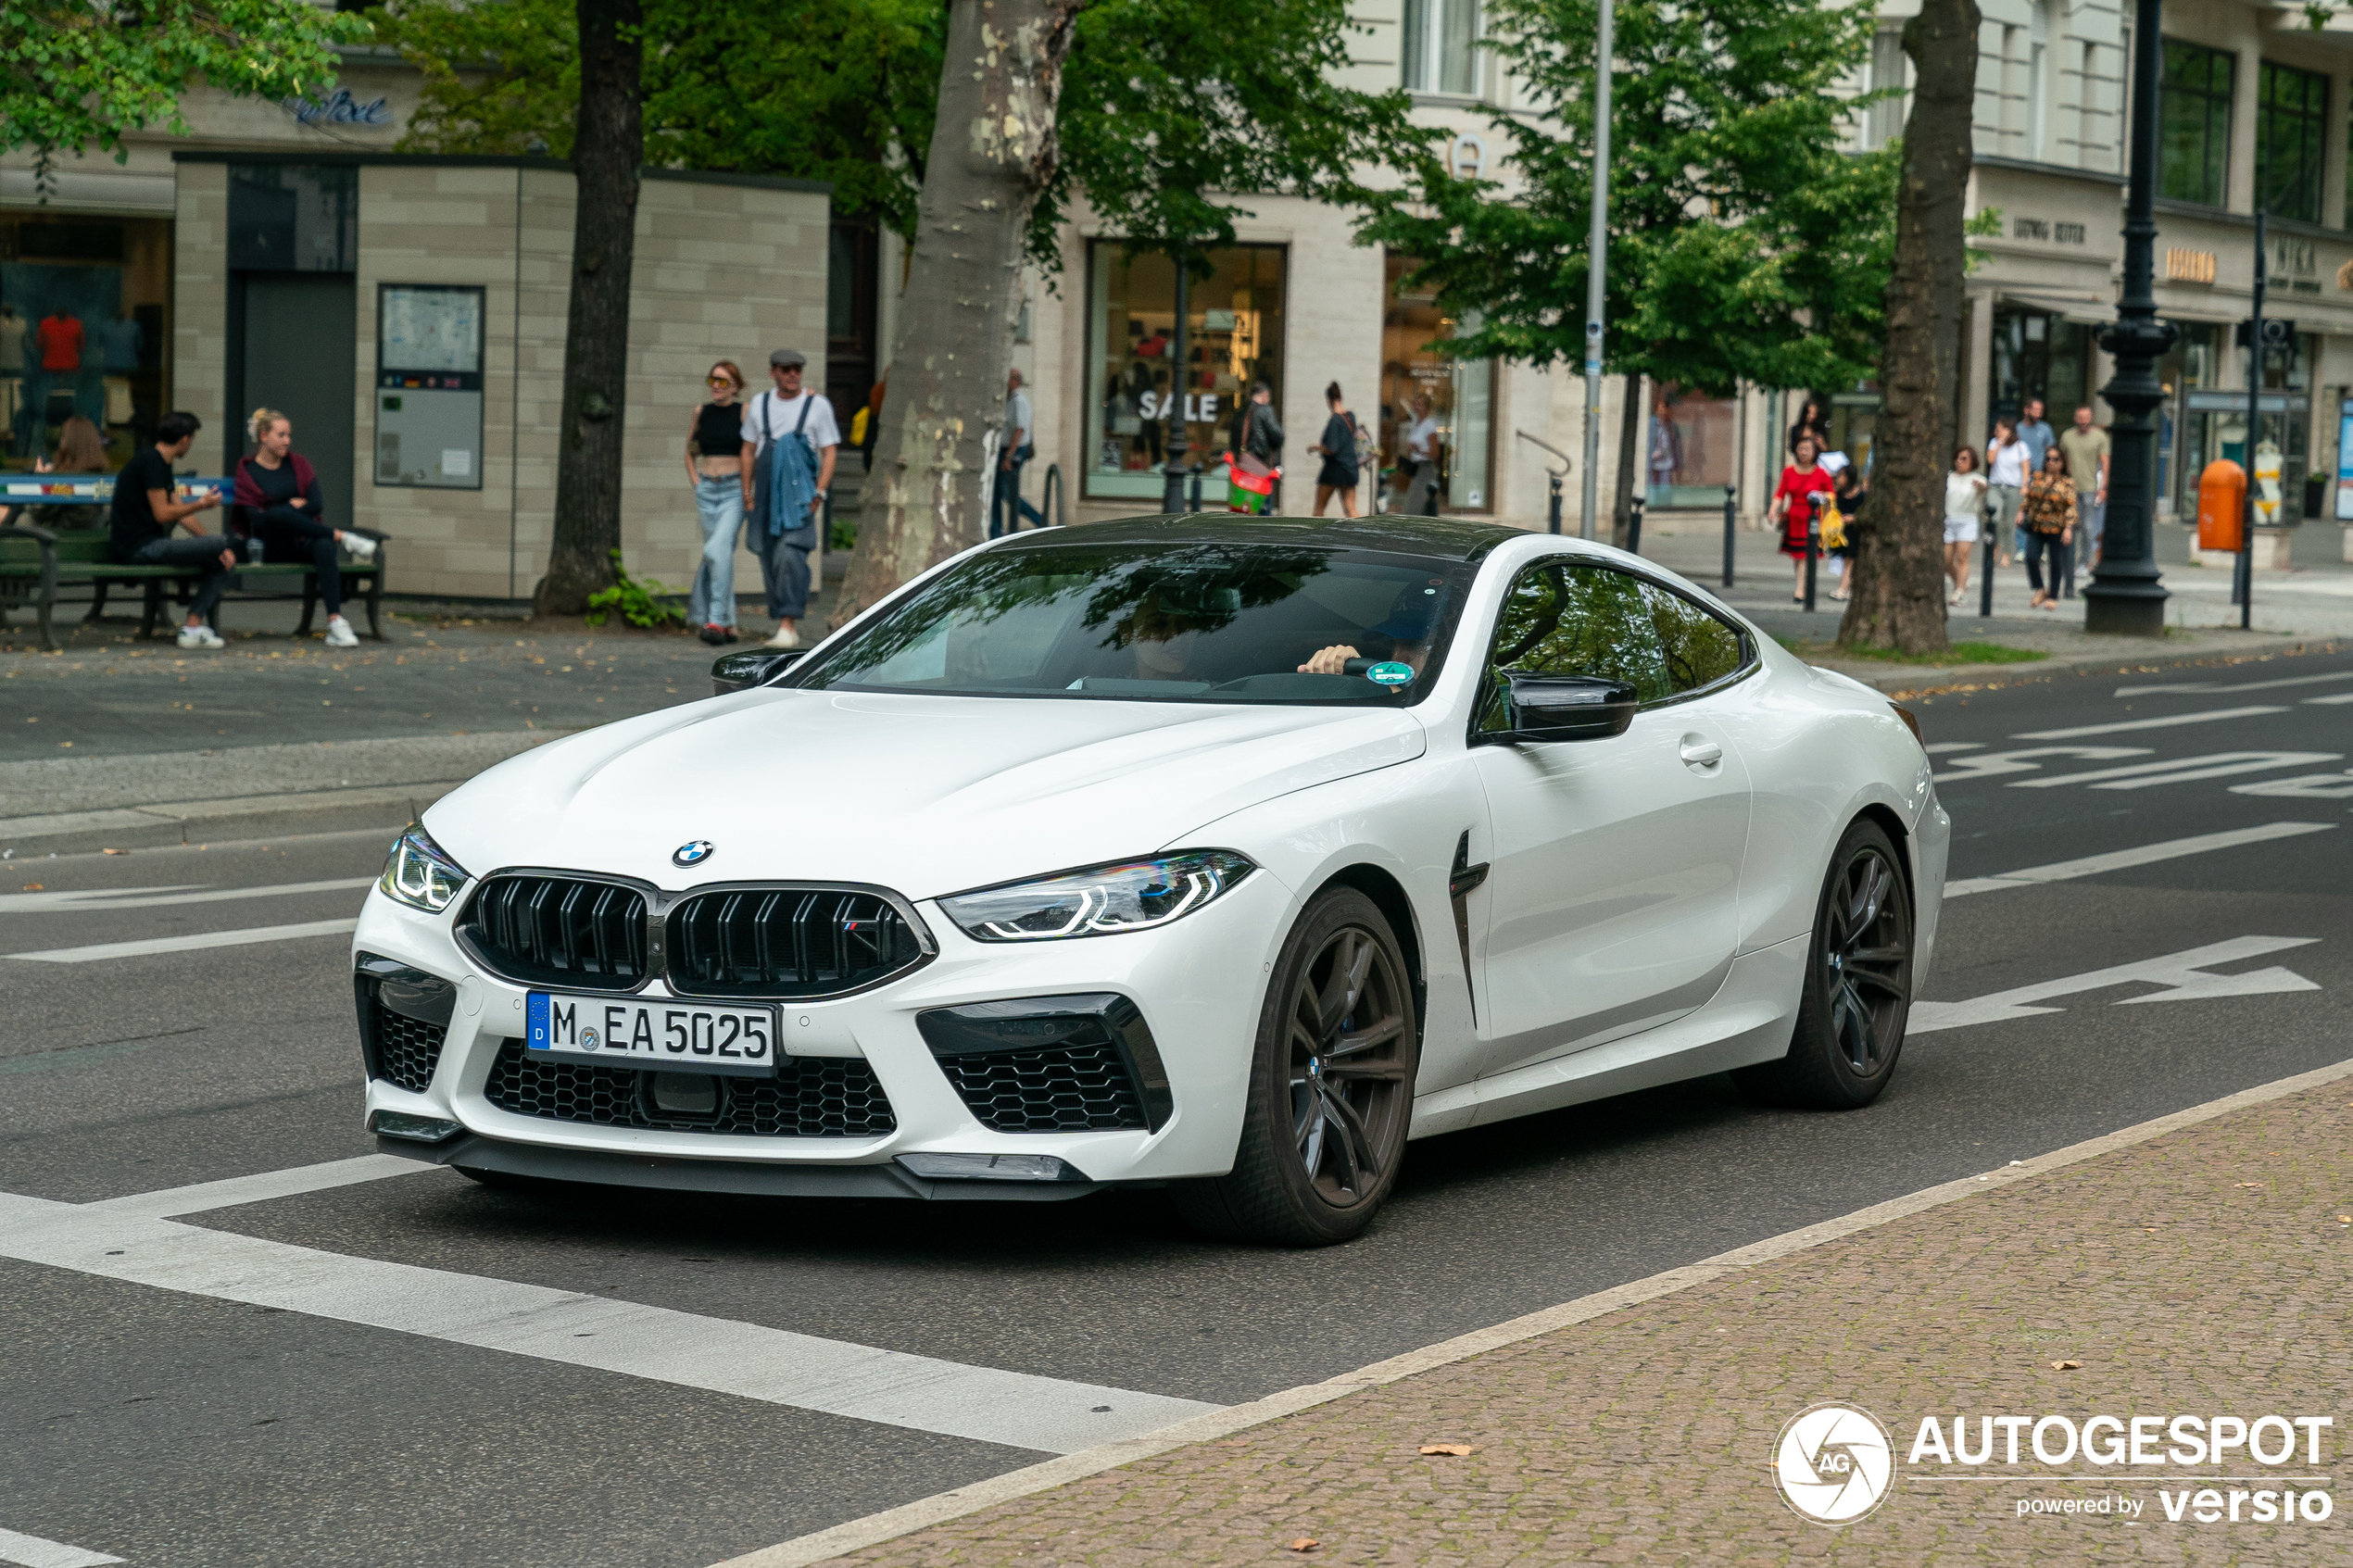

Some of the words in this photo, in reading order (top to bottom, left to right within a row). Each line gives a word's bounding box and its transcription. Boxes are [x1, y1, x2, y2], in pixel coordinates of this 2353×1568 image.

[535, 1027, 545, 1041] D
[553, 999, 576, 1045] M
[604, 1005, 654, 1051] EA
[665, 1010, 767, 1058] 5025
